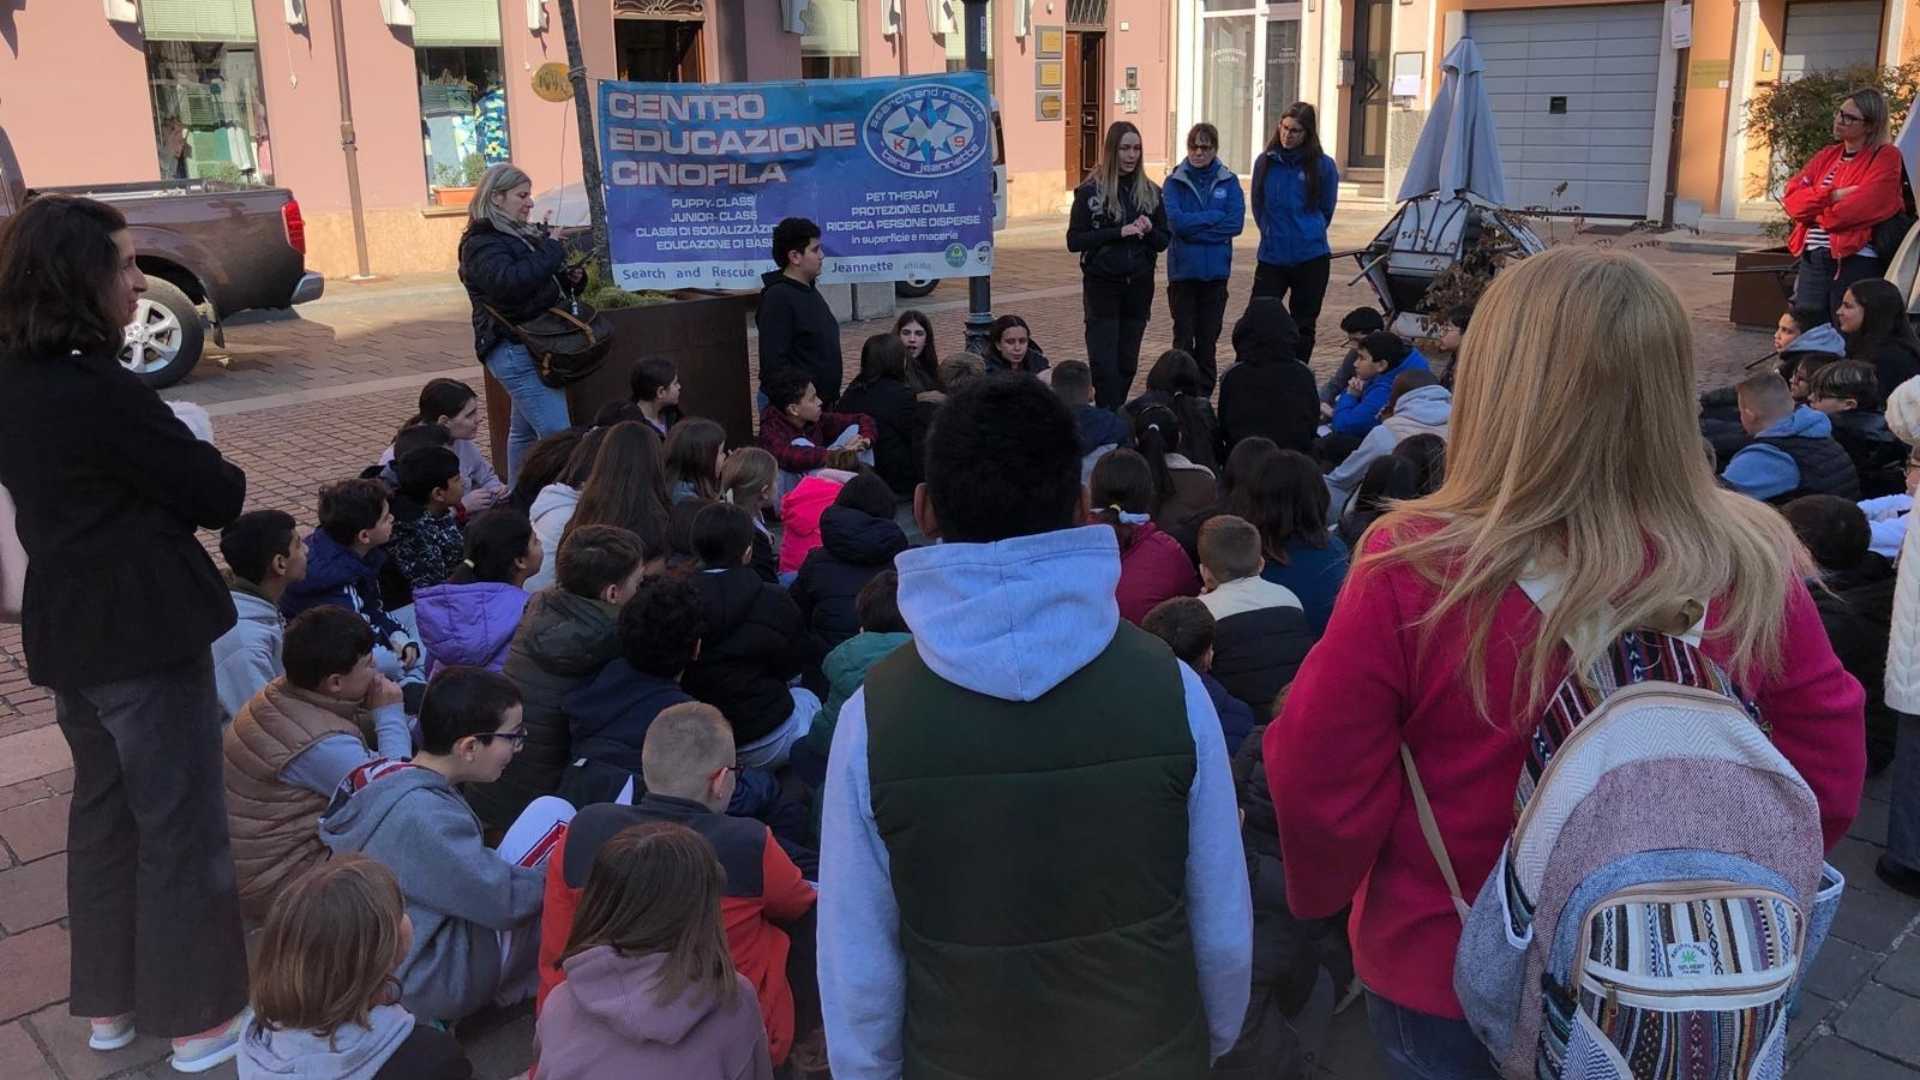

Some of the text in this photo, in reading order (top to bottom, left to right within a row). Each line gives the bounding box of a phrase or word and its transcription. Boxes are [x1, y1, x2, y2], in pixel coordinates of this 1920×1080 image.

[607, 92, 766, 120] CENTRO
[870, 88, 985, 128] search and rescue
[608, 122, 858, 155] EDUCAZIONE
[893, 138, 905, 151] K
[610, 160, 788, 187] CINOFILA
[866, 190, 940, 202] PET THERAPY
[719, 210, 758, 221] CLASS
[852, 203, 955, 217] PROTEZIONE CIVILE
[826, 215, 981, 232] RICERCA PERSONE DISPERSE
[635, 227, 678, 237] CLASSI
[679, 227, 691, 237] DI
[851, 231, 958, 246] in superficie e macerie
[656, 239, 731, 251] EDUCAZIONE
[732, 239, 744, 249] DI
[622, 267, 666, 280] Search
[676, 266, 701, 278] and
[712, 266, 754, 278] Rescue
[832, 260, 894, 273] Jeannette
